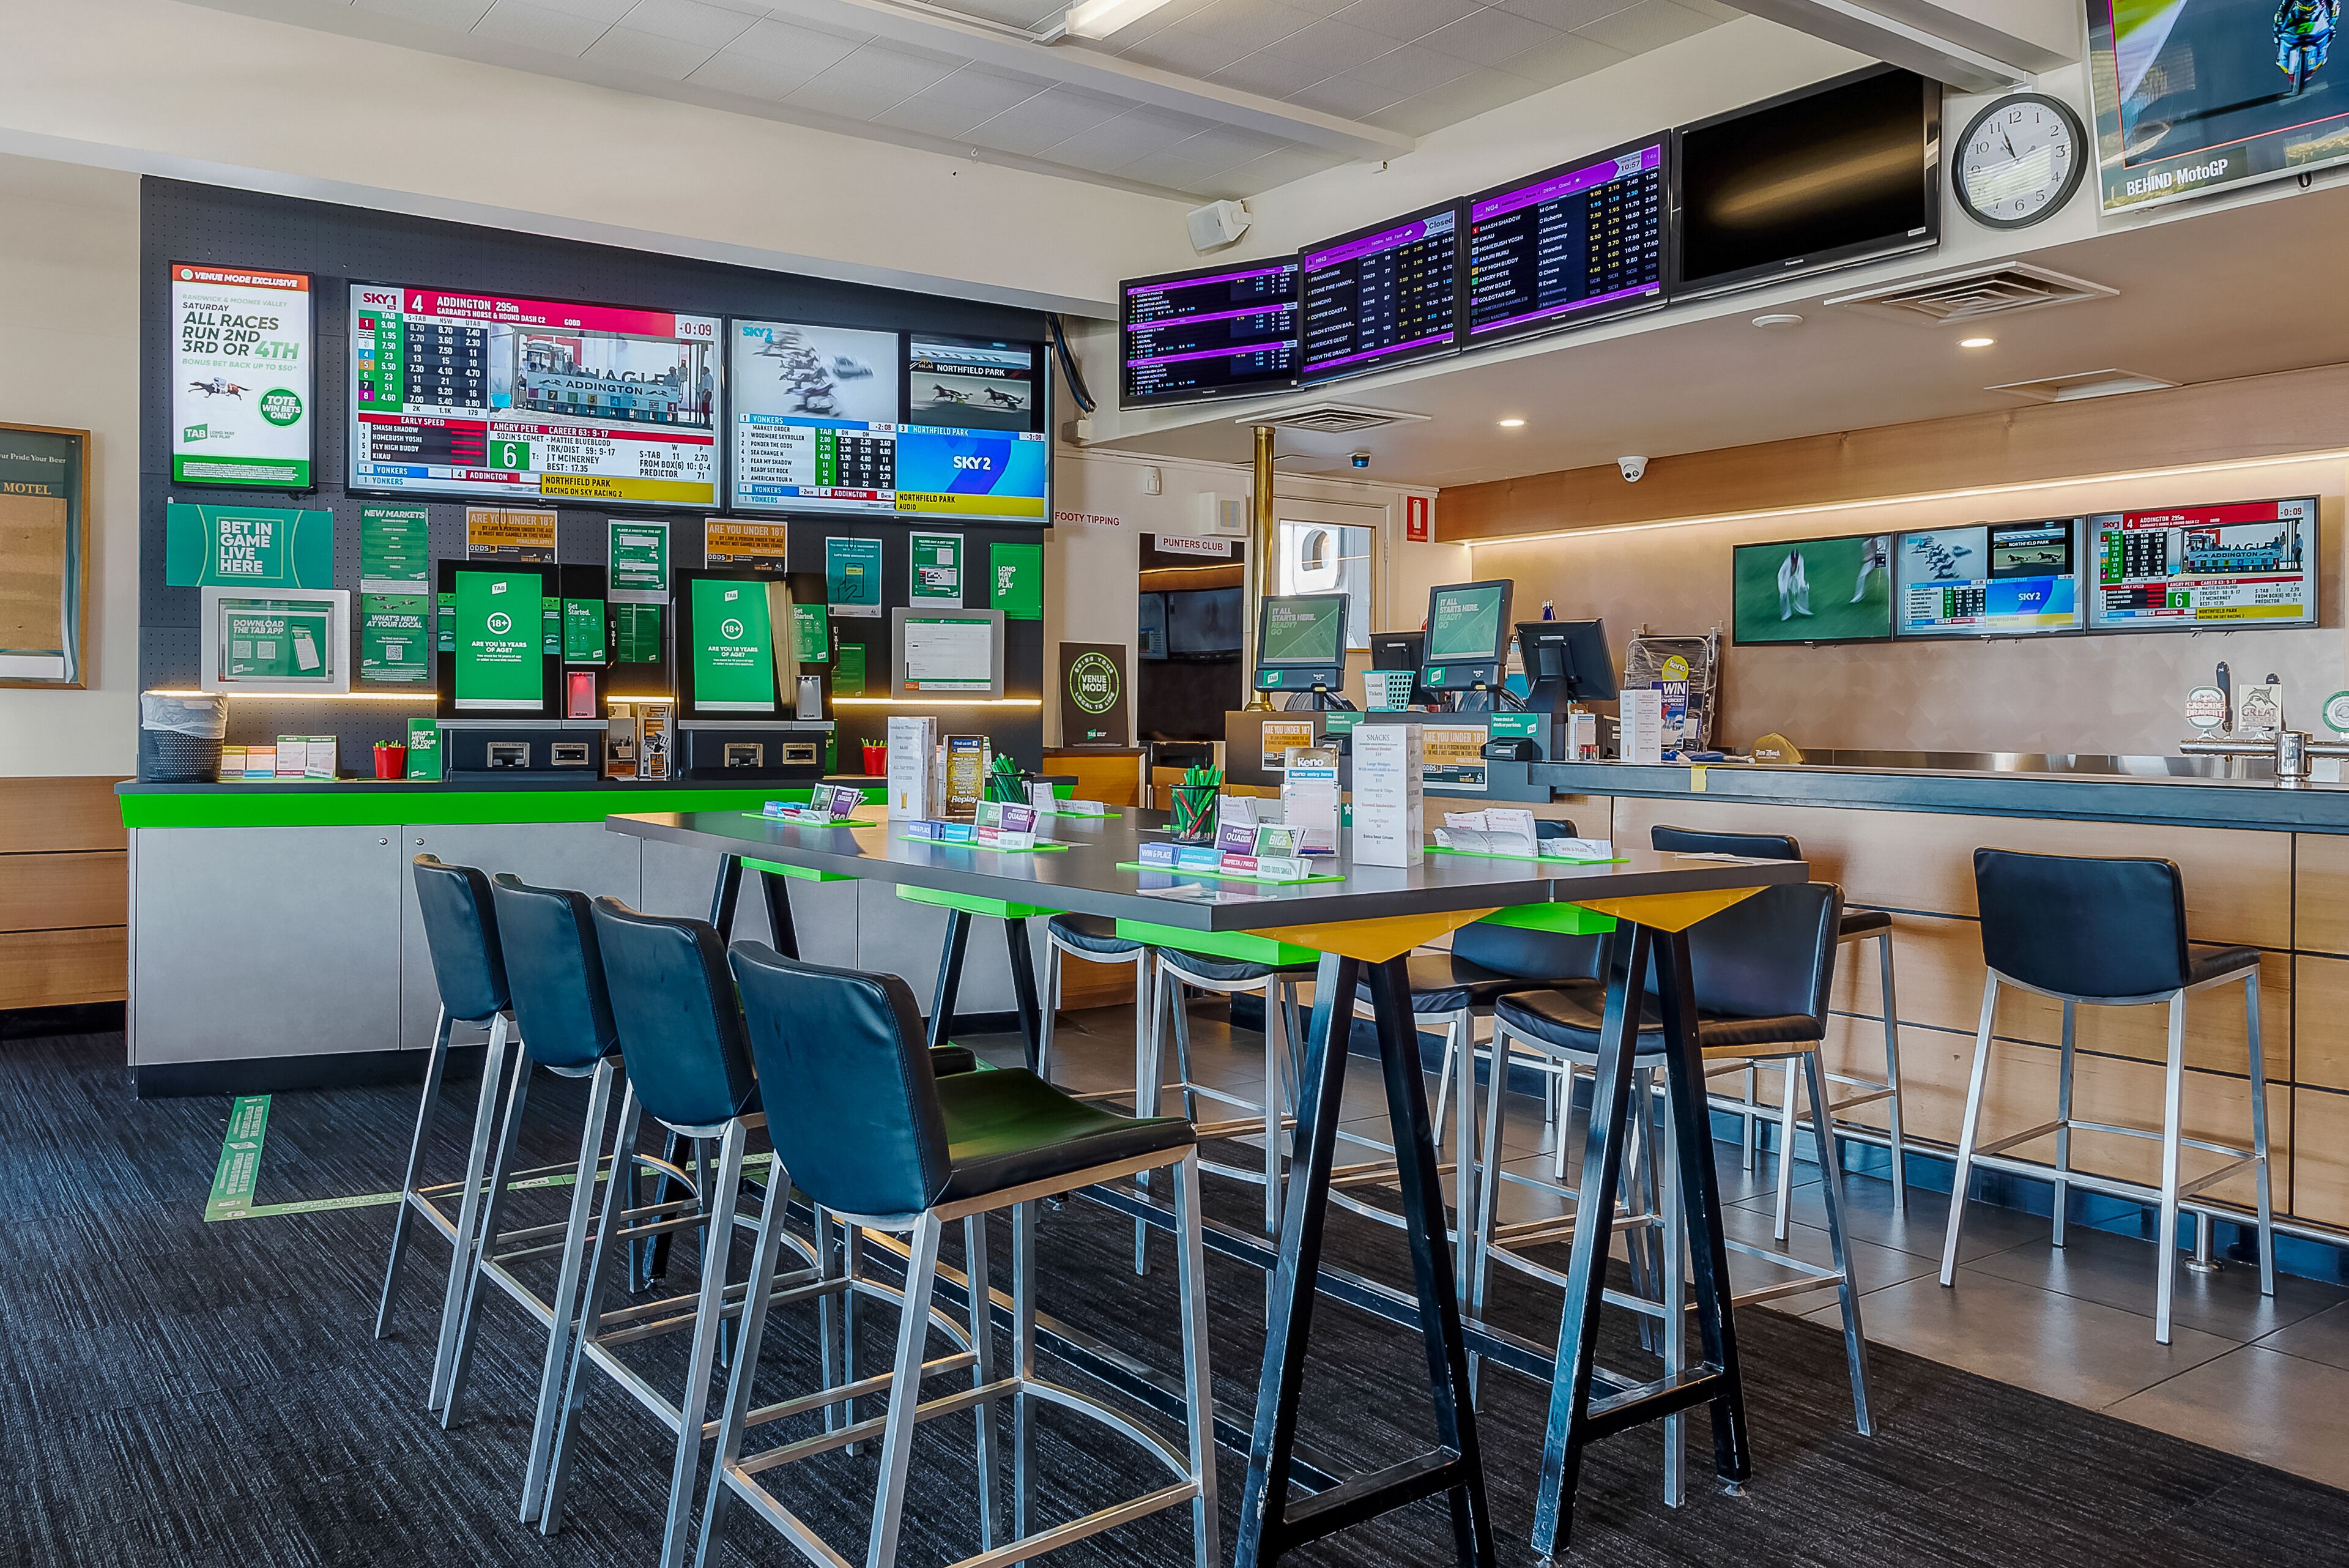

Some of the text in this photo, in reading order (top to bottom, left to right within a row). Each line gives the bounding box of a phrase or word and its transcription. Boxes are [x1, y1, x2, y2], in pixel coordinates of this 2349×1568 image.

[2009, 111, 2022, 124] 12
[2036, 112, 2039, 124] 1
[1991, 122, 2000, 134] 11
[2050, 125, 2059, 136] 2
[1976, 141, 1989, 154] 10
[2056, 145, 2065, 157] 3
[1620, 160, 1641, 171] 10:57
[2126, 159, 2228, 196] BEHIND MotoGP
[1485, 203, 1498, 212] NG4
[1429, 217, 1453, 229] Closed
[1480, 215, 1521, 232] SMASH SHADOW
[195, 271, 297, 288] VENUE MODE EXCLUSIVE
[182, 294, 221, 303] RANDWICK
[412, 294, 423, 312] 4
[437, 296, 519, 313] ADDINGTON 295m
[182, 302, 229, 312] SATURDAY
[437, 307, 471, 317] GARRARD'S
[184, 311, 280, 330] ALL RACES
[564, 318, 581, 327] GOOD
[182, 327, 261, 343] RUN 2ND
[182, 340, 300, 360] 3RD OR 4TH
[229, 360, 251, 369] BACK
[937, 363, 1005, 376] NORTHFIELD PARK
[565, 379, 643, 396] ADDINGTON
[267, 396, 296, 406] TOTE
[262, 404, 301, 414] WIN BETS
[270, 411, 293, 420] ONLY
[753, 415, 783, 424] YONKERS
[185, 429, 206, 439] TAB
[494, 423, 609, 437] ANGRY PETE CAREER 63: 9-17
[503, 443, 517, 467] 6
[377, 466, 407, 475] YONKERS
[470, 472, 508, 481] ADDINGTON
[546, 476, 610, 487] NORTHFIELD PARK
[4, 482, 51, 495] MOTEL
[899, 493, 956, 503] NORTHFIELD PARK
[386, 510, 425, 519] MARKETS
[2280, 508, 2302, 516] -0:09
[1055, 511, 1119, 526] FOOTY TIPPING
[220, 521, 272, 535] BET IN
[710, 524, 784, 536] ARE YOU UNDER 18?
[220, 533, 270, 548] GAME
[1163, 538, 1223, 550] PUNTERS CLUB
[220, 547, 255, 560] LIVE
[220, 559, 263, 573] HERE
[491, 619, 508, 628] 18+
[1669, 660, 1686, 672] Keno
[1082, 683, 1107, 692] MODE
[1663, 683, 1685, 695] WIN
[2186, 709, 2225, 719] DRAUGHT
[2241, 708, 2277, 716] GREAT
[1297, 757, 1324, 767] Keno
[1268, 835, 1288, 845] BIG6
[1157, 850, 1171, 859] PLACE
